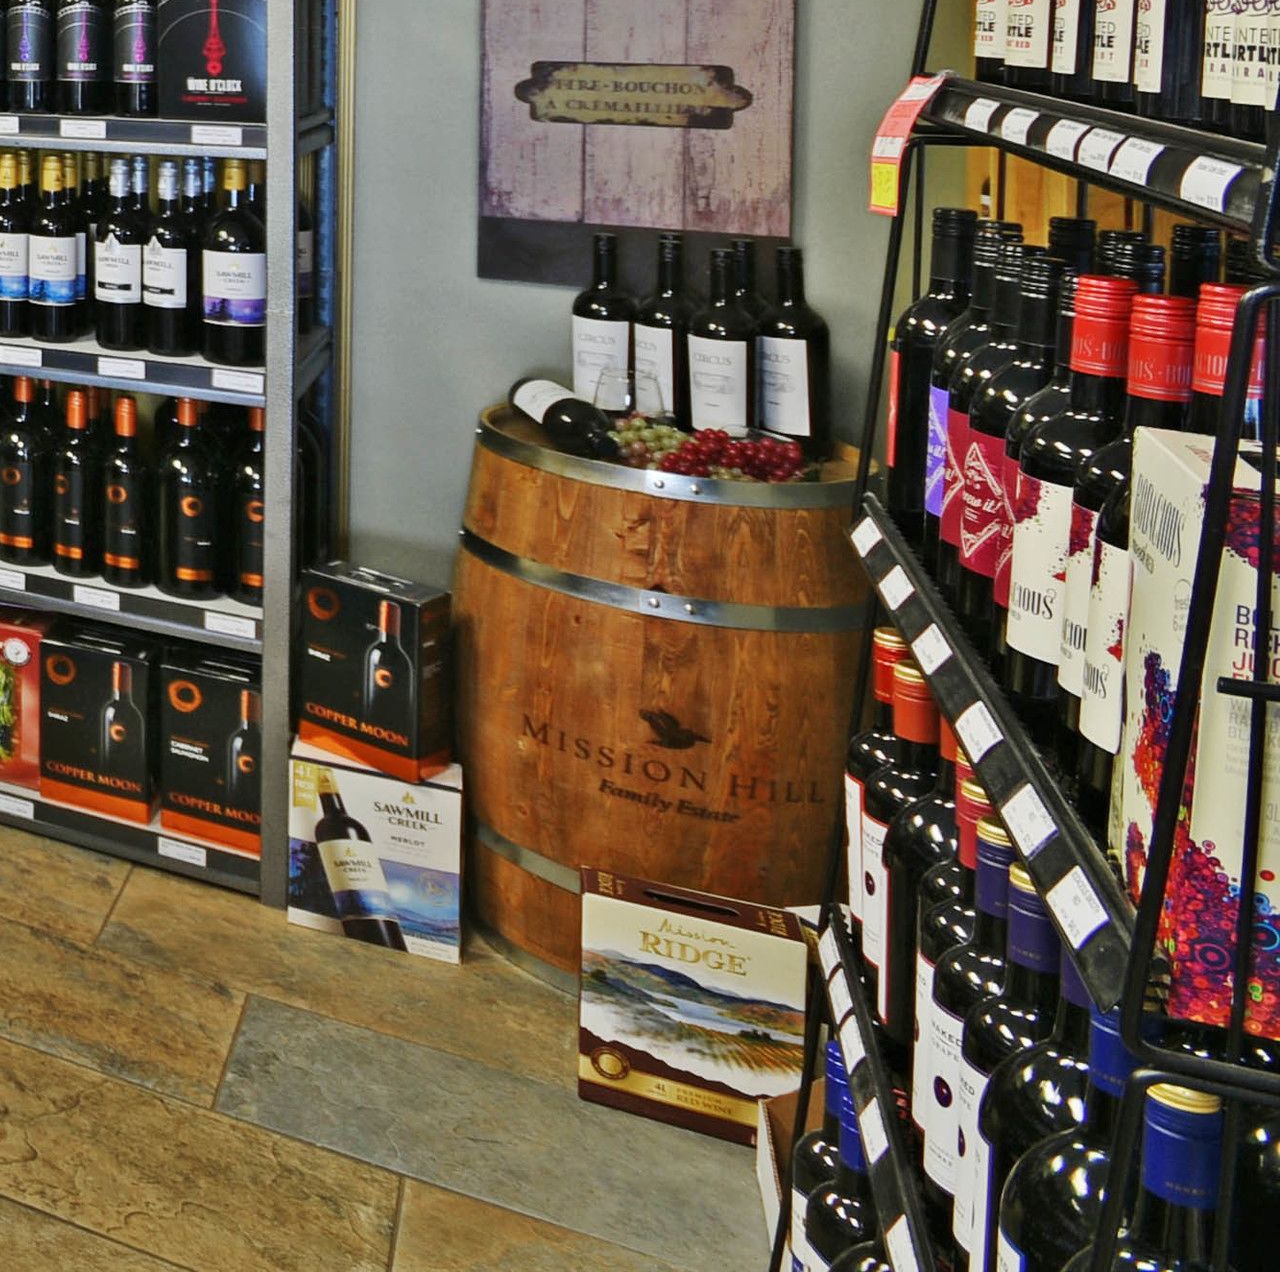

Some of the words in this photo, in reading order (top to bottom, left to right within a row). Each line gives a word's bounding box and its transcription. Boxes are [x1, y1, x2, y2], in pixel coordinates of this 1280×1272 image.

[693, 351, 731, 365] CIRCUS
[305, 701, 358, 729] COPPER
[360, 720, 409, 746] MOON
[171, 739, 203, 755] CABERNET
[521, 713, 708, 794] MISSION
[730, 778, 826, 806] HILL
[47, 760, 95, 784] COPPER
[97, 771, 143, 793] MOON
[169, 791, 222, 816] COPPER
[224, 804, 261, 825] MOO
[374, 800, 442, 824] SAWMILL
[599, 778, 674, 814] Family
[676, 800, 742, 825] Estate
[389, 816, 427, 831] CREEK
[390, 835, 426, 847] MERLOT
[639, 930, 747, 976] RIDGE
[698, 1099, 733, 1116] WINE
